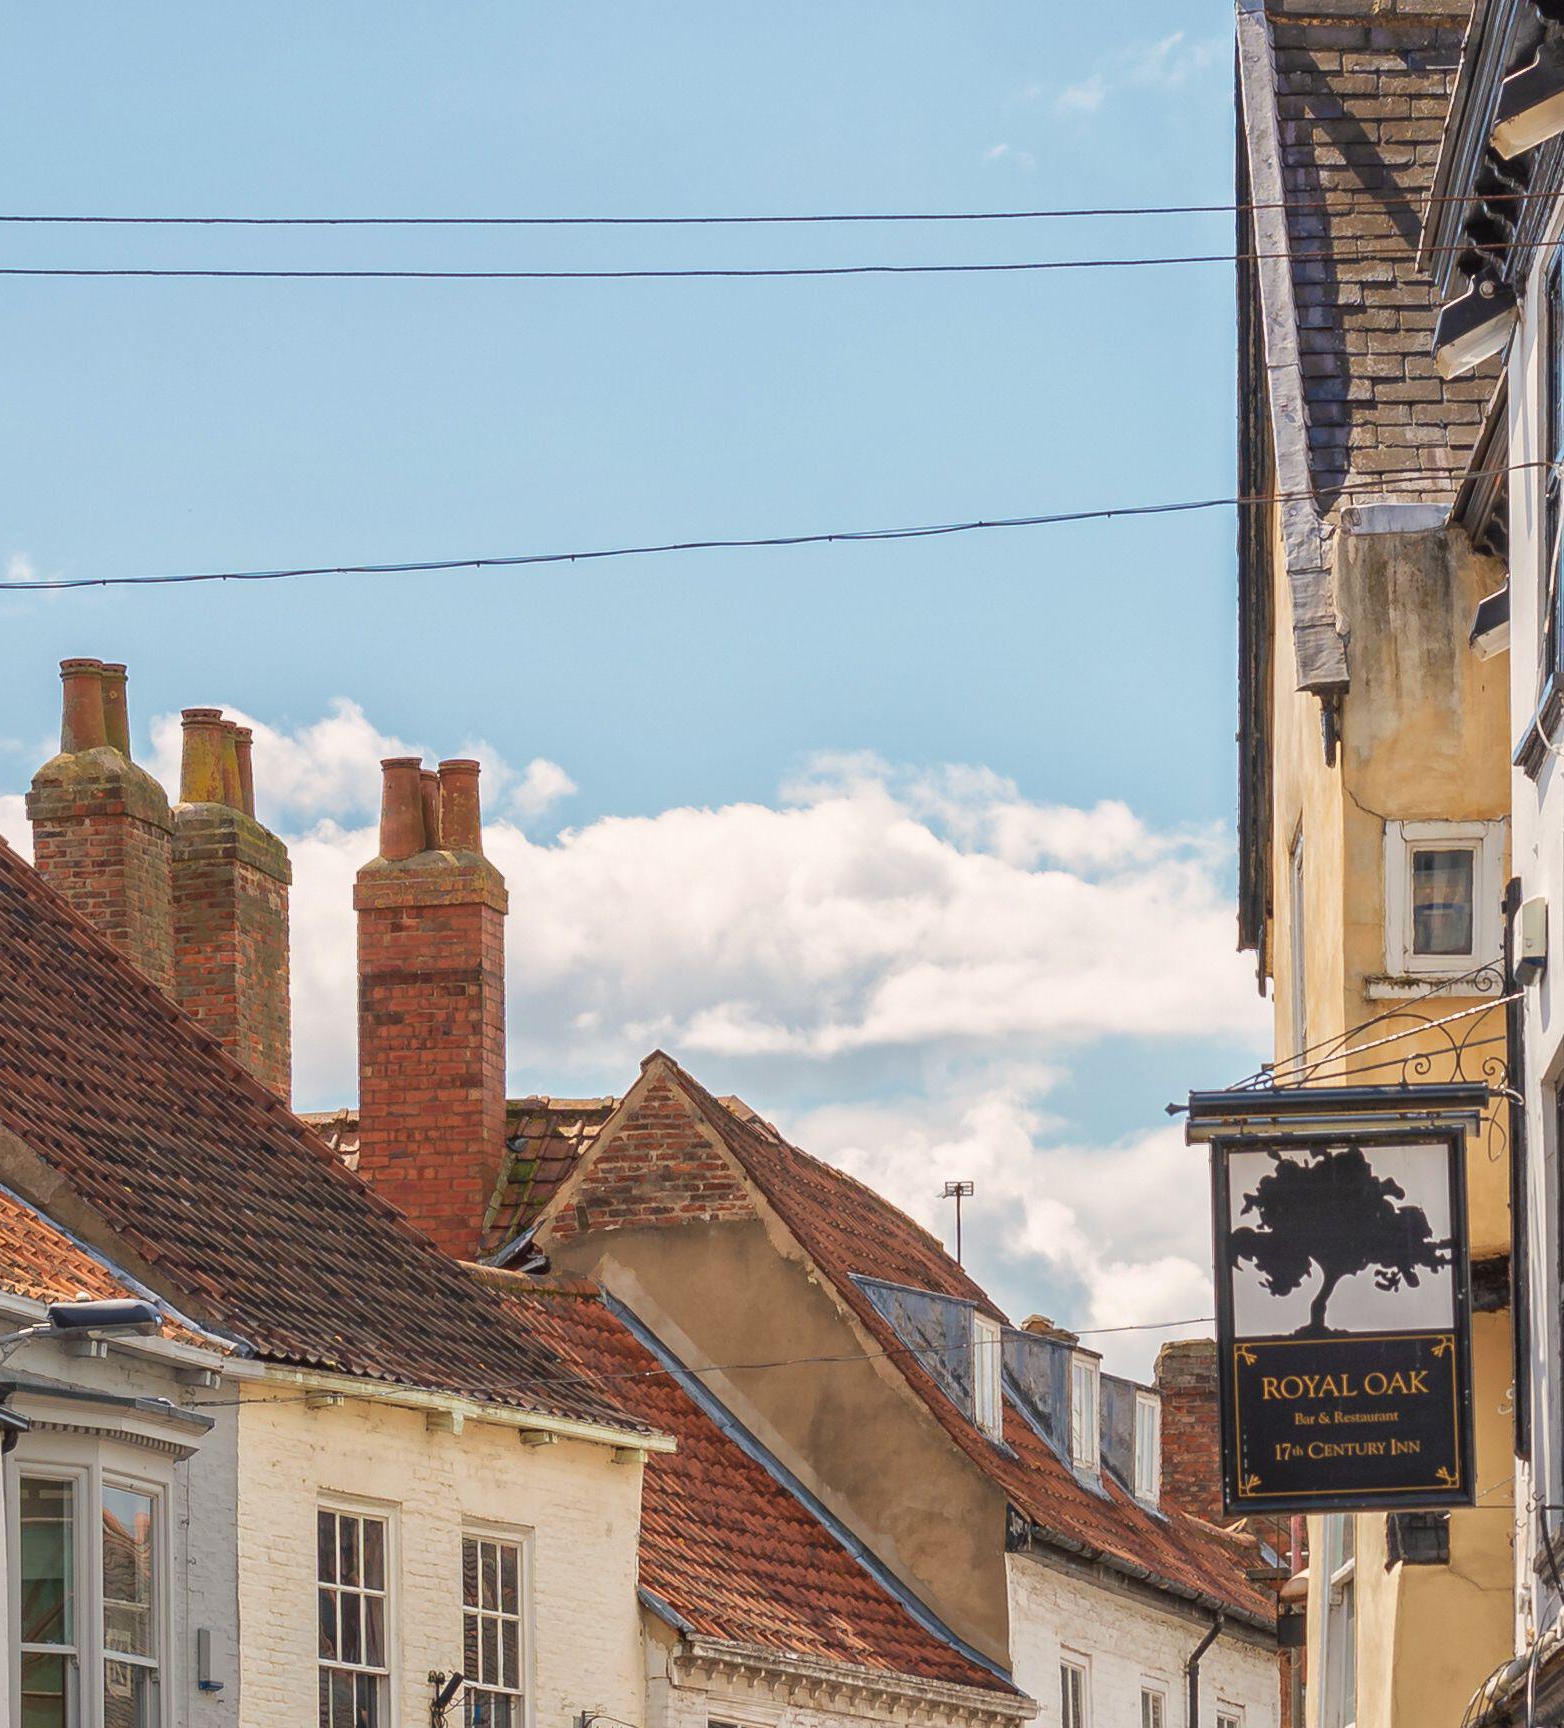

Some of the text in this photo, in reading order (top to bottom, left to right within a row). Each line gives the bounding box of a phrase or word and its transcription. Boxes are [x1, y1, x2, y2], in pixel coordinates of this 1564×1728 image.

[1262, 1369, 1430, 1401] ROYAL OAK
[1294, 1410, 1399, 1426] Bar & Restaurant
[1274, 1438, 1422, 1461] 17th CENTURY INN
